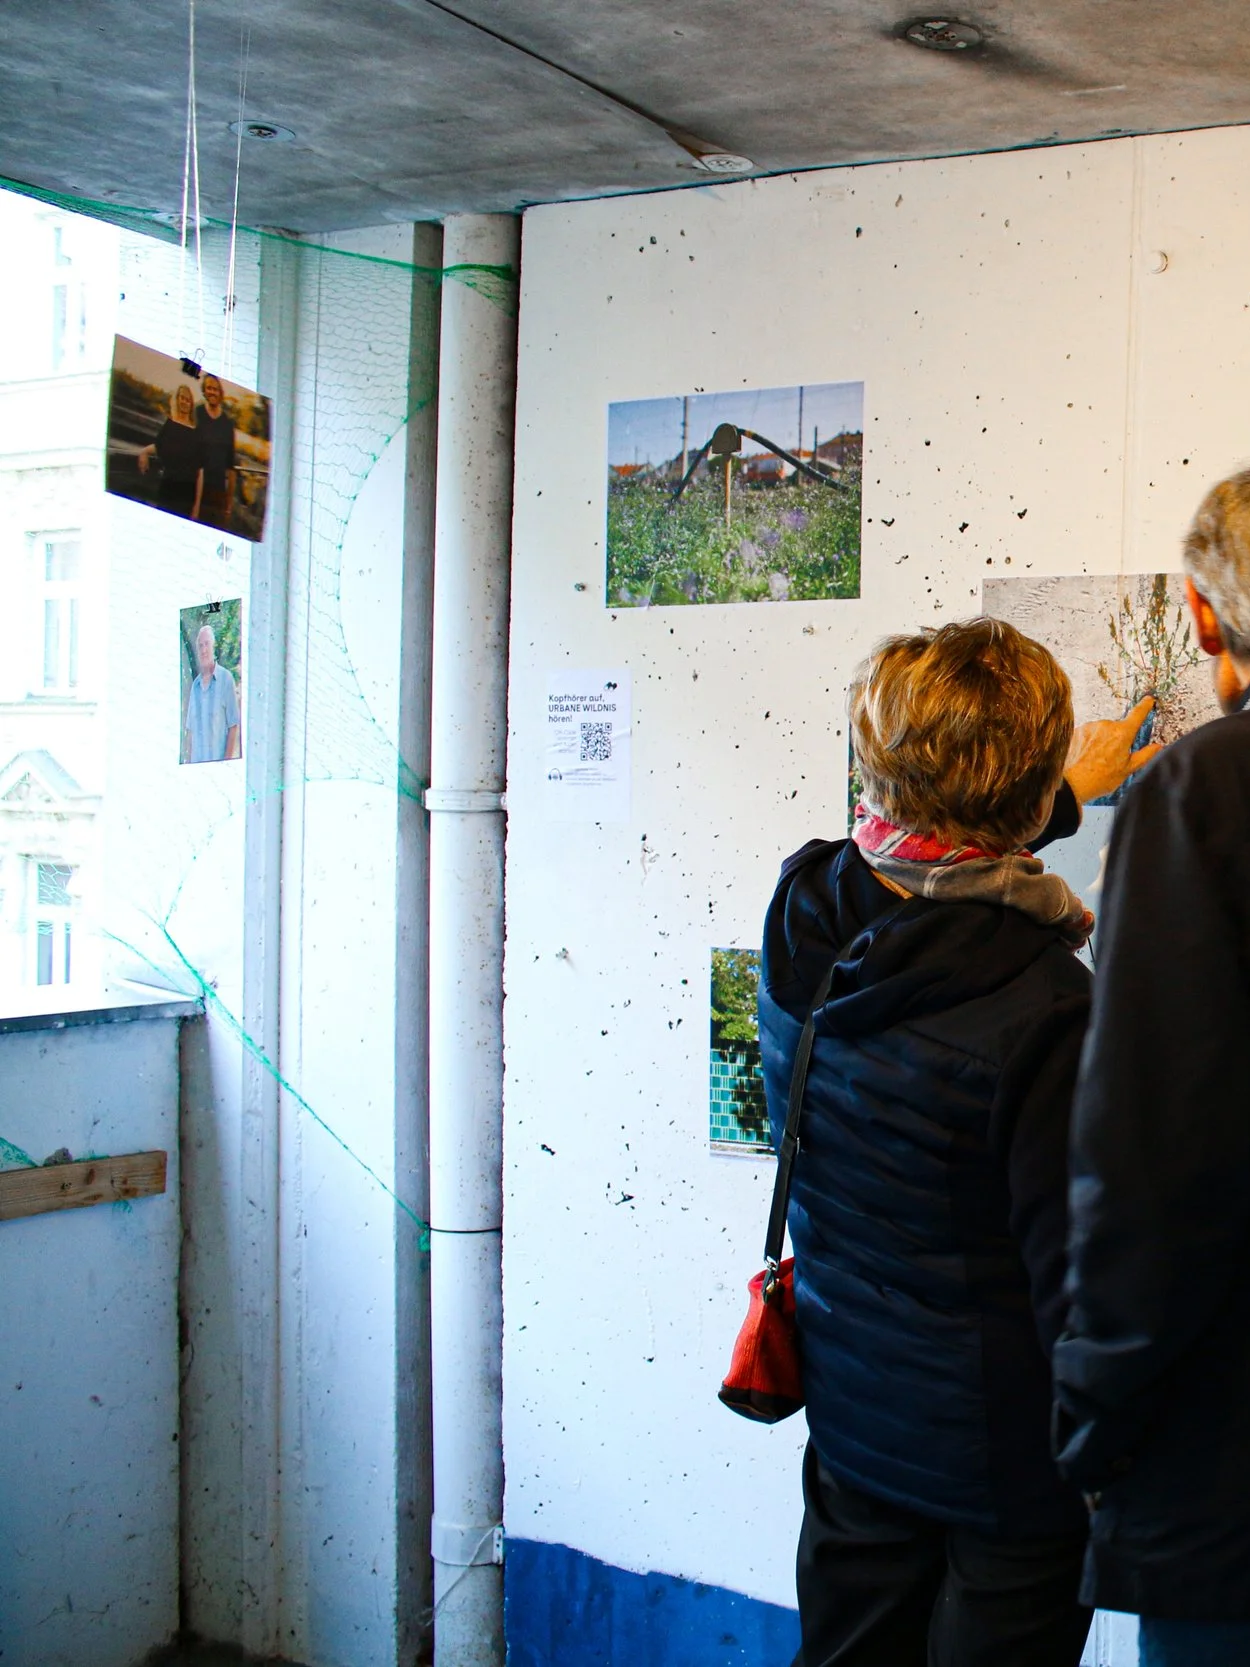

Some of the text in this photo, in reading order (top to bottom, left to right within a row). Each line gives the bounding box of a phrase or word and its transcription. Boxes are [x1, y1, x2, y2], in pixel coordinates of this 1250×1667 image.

[548, 694, 587, 703] Kopfhörer
[548, 703, 617, 712] URBANE WILDNIS
